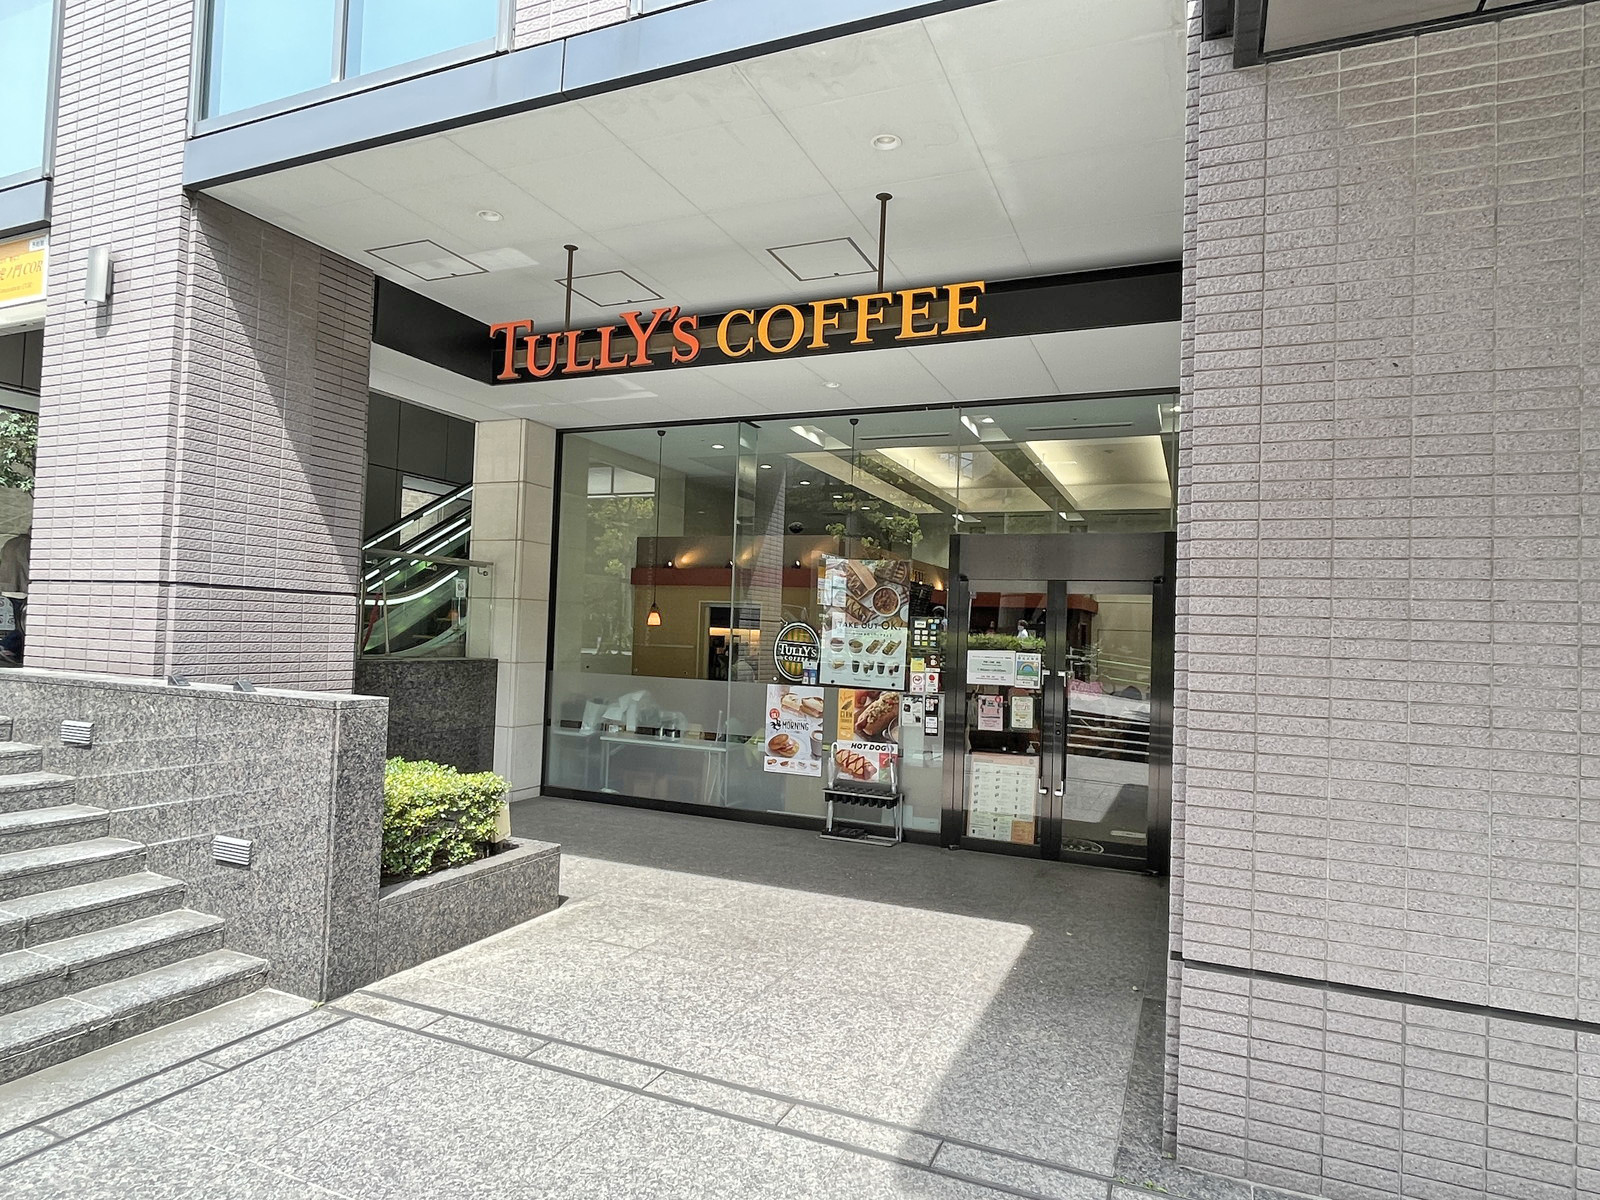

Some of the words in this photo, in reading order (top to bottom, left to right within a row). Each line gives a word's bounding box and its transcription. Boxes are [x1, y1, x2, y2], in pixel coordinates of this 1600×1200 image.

[716, 280, 988, 359] COFFEE
[838, 620, 859, 629] TAKE
[861, 622, 878, 630] OUT
[782, 720, 809, 731] MORNING
[850, 742, 868, 750] HOT
